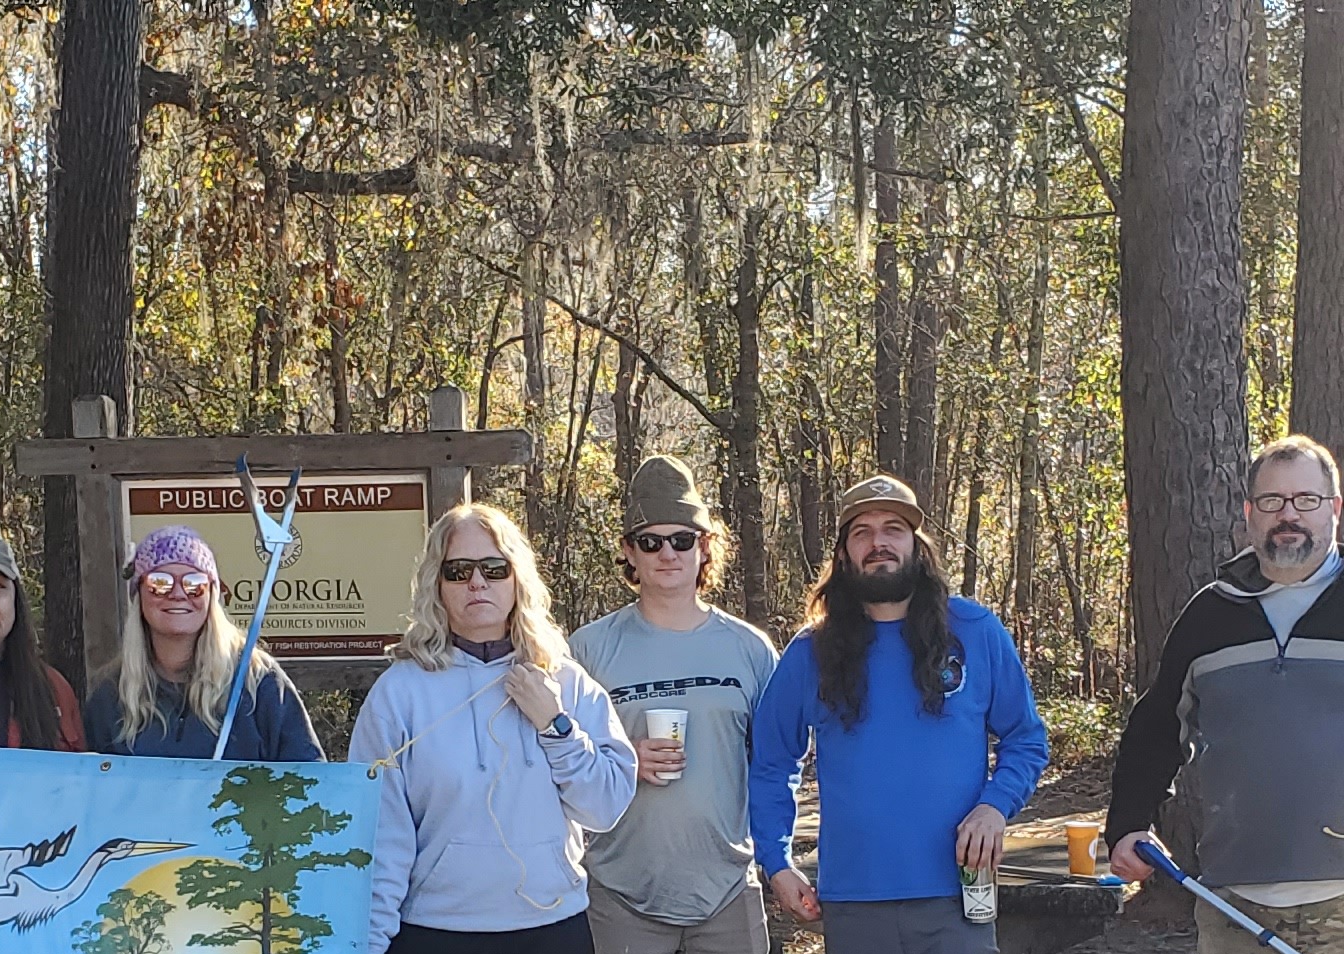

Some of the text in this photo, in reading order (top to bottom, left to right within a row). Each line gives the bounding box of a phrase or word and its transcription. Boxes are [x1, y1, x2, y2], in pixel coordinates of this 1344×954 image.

[159, 489, 245, 509] PUBLIC
[324, 487, 392, 506] RAMP
[234, 579, 363, 602] GORGIA
[261, 618, 313, 629] ESOURCES
[316, 618, 367, 629] DIVISION
[294, 641, 347, 650] RESTORATION
[348, 640, 383, 649] PROJECT
[608, 676, 743, 700] STEEDA
